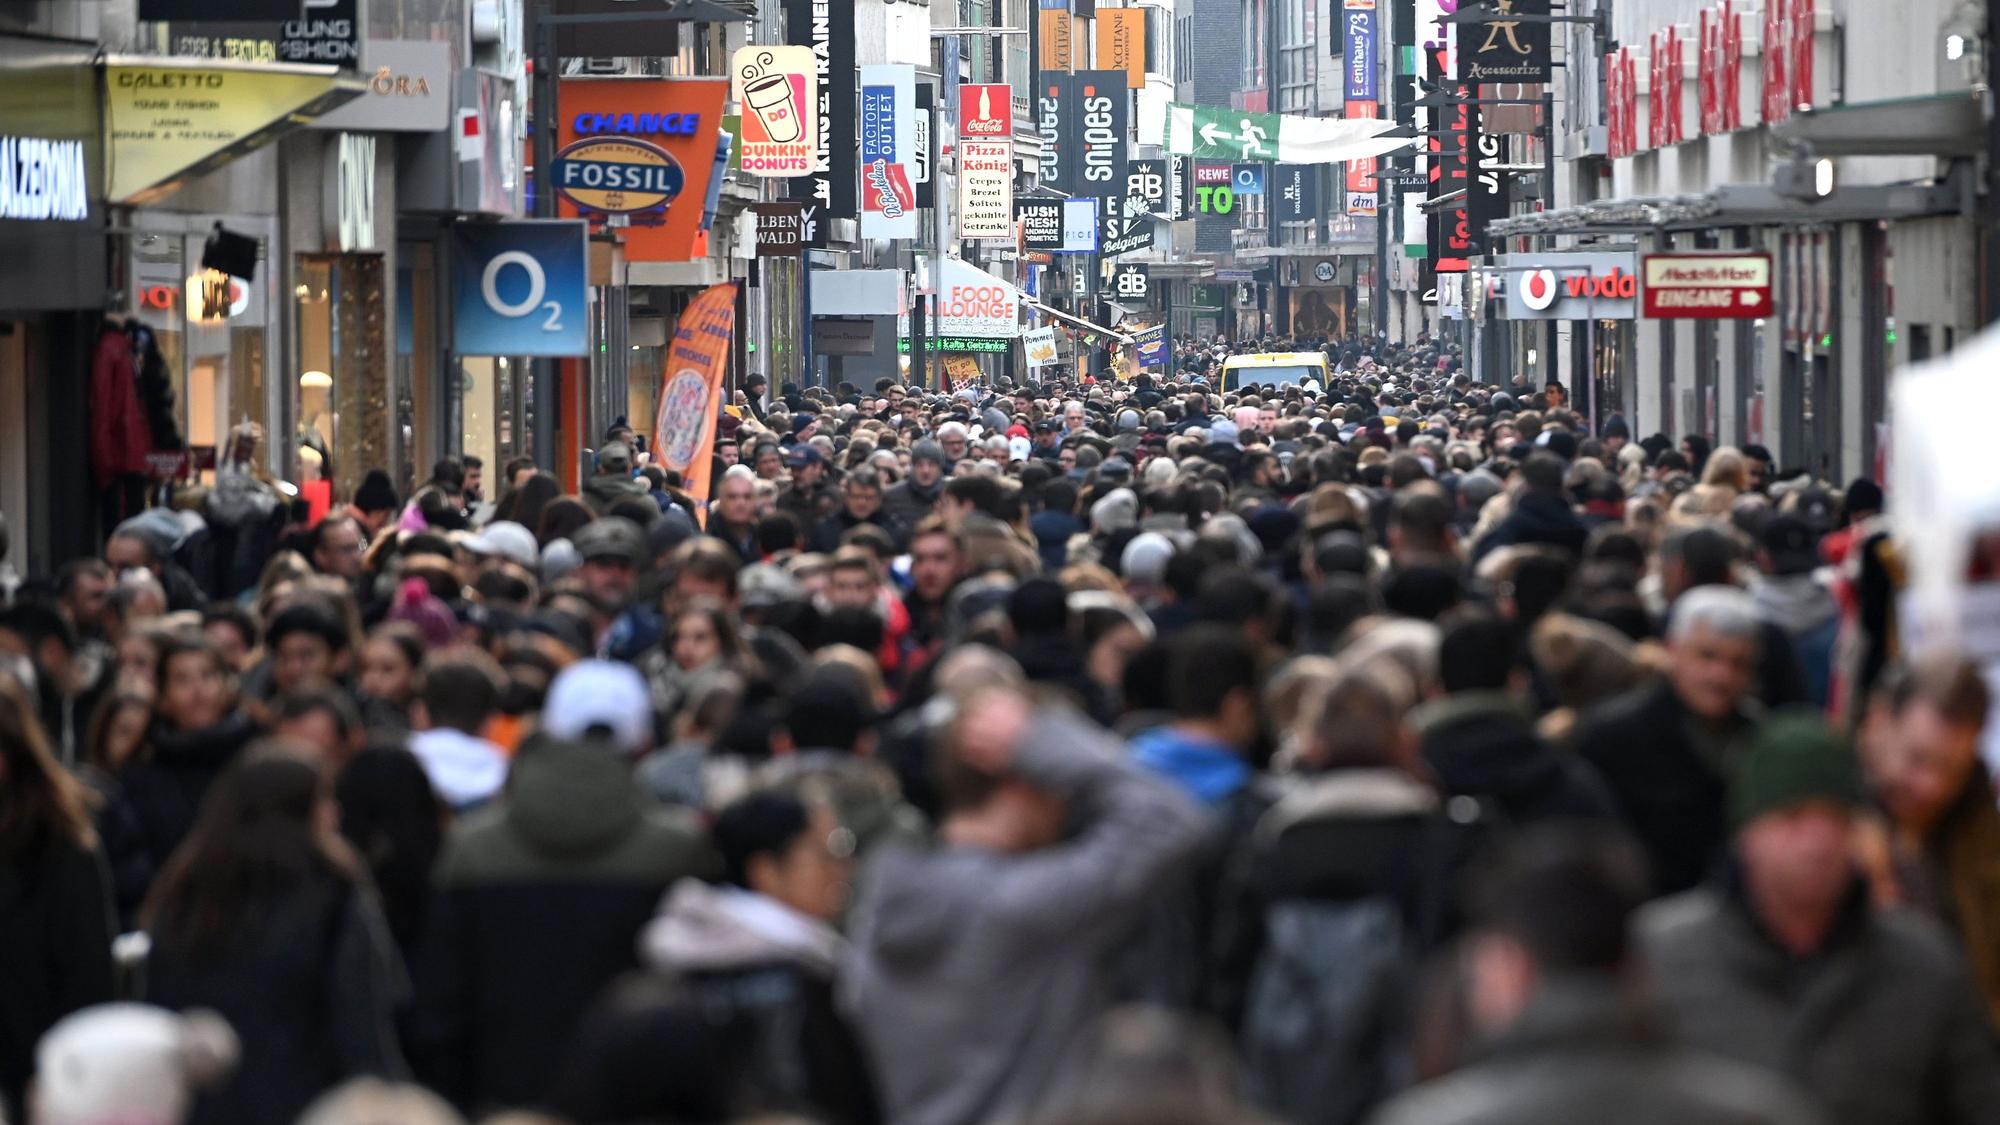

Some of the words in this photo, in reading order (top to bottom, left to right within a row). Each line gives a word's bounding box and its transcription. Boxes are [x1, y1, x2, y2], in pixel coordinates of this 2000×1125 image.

[284, 19, 350, 37] OUNG
[281, 41, 358, 59] SHION
[812, 0, 829, 85] TRAINE
[1467, 61, 1541, 79] Accessorize
[573, 111, 700, 134] CHANGE
[865, 94, 877, 155] FACTORY
[880, 93, 892, 155] OUTLET
[1083, 96, 1118, 181] snipes
[741, 145, 811, 157] DUNKIN'
[966, 145, 1005, 156] Pizza
[742, 158, 808, 170] DONUTS
[963, 159, 1008, 173] König
[0, 134, 88, 221] ALZEDONIA
[563, 163, 671, 191] FOSSIL
[969, 177, 1002, 187] Crepes
[1198, 168, 1229, 181] REWE
[971, 188, 1001, 197] Brezel
[1196, 186, 1232, 214] TO
[1284, 185, 1294, 199] XL
[969, 200, 1002, 208] Softeis
[1353, 195, 1373, 207] dm
[1019, 206, 1058, 217] LUSH
[756, 231, 797, 244] WALD
[1103, 232, 1151, 253] Belgique
[952, 287, 1005, 303] FOOD
[1655, 290, 1733, 308] EINGANG
[943, 302, 1014, 318] LOUNGE
